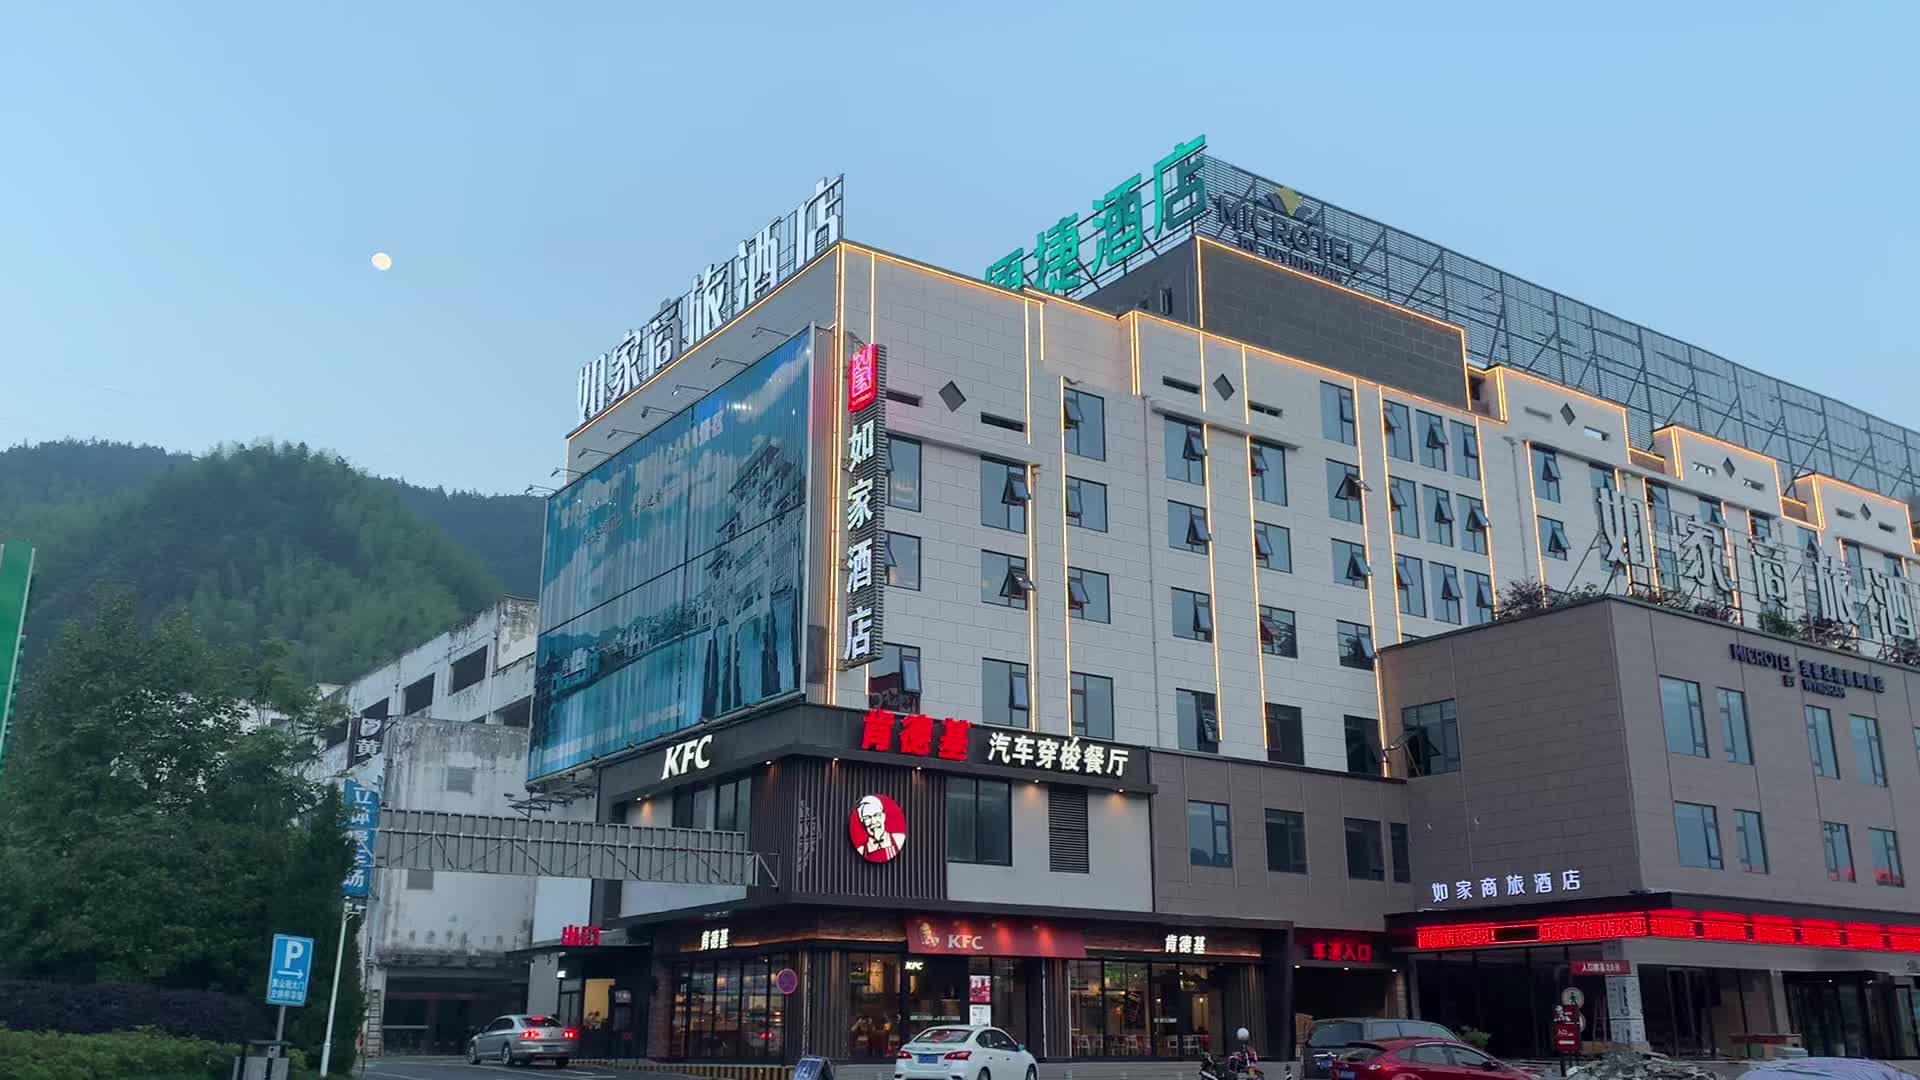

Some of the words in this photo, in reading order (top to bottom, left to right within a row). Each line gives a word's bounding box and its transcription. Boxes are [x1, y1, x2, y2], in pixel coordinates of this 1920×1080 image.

[1218, 195, 1357, 270] MICROTEL
[576, 173, 844, 424] 如家商旅酒店
[845, 419, 874, 661] 如家酒店
[661, 735, 712, 780] KFC
[861, 708, 972, 762] 肯德基
[988, 732, 1129, 777] 汽车穿梭餐厅
[1431, 870, 1581, 903] 如家商旅酒店
[284, 940, 304, 969] P
[947, 934, 984, 950] KFC
[1165, 934, 1206, 954] 肯德基
[905, 961, 923, 970] KFC
